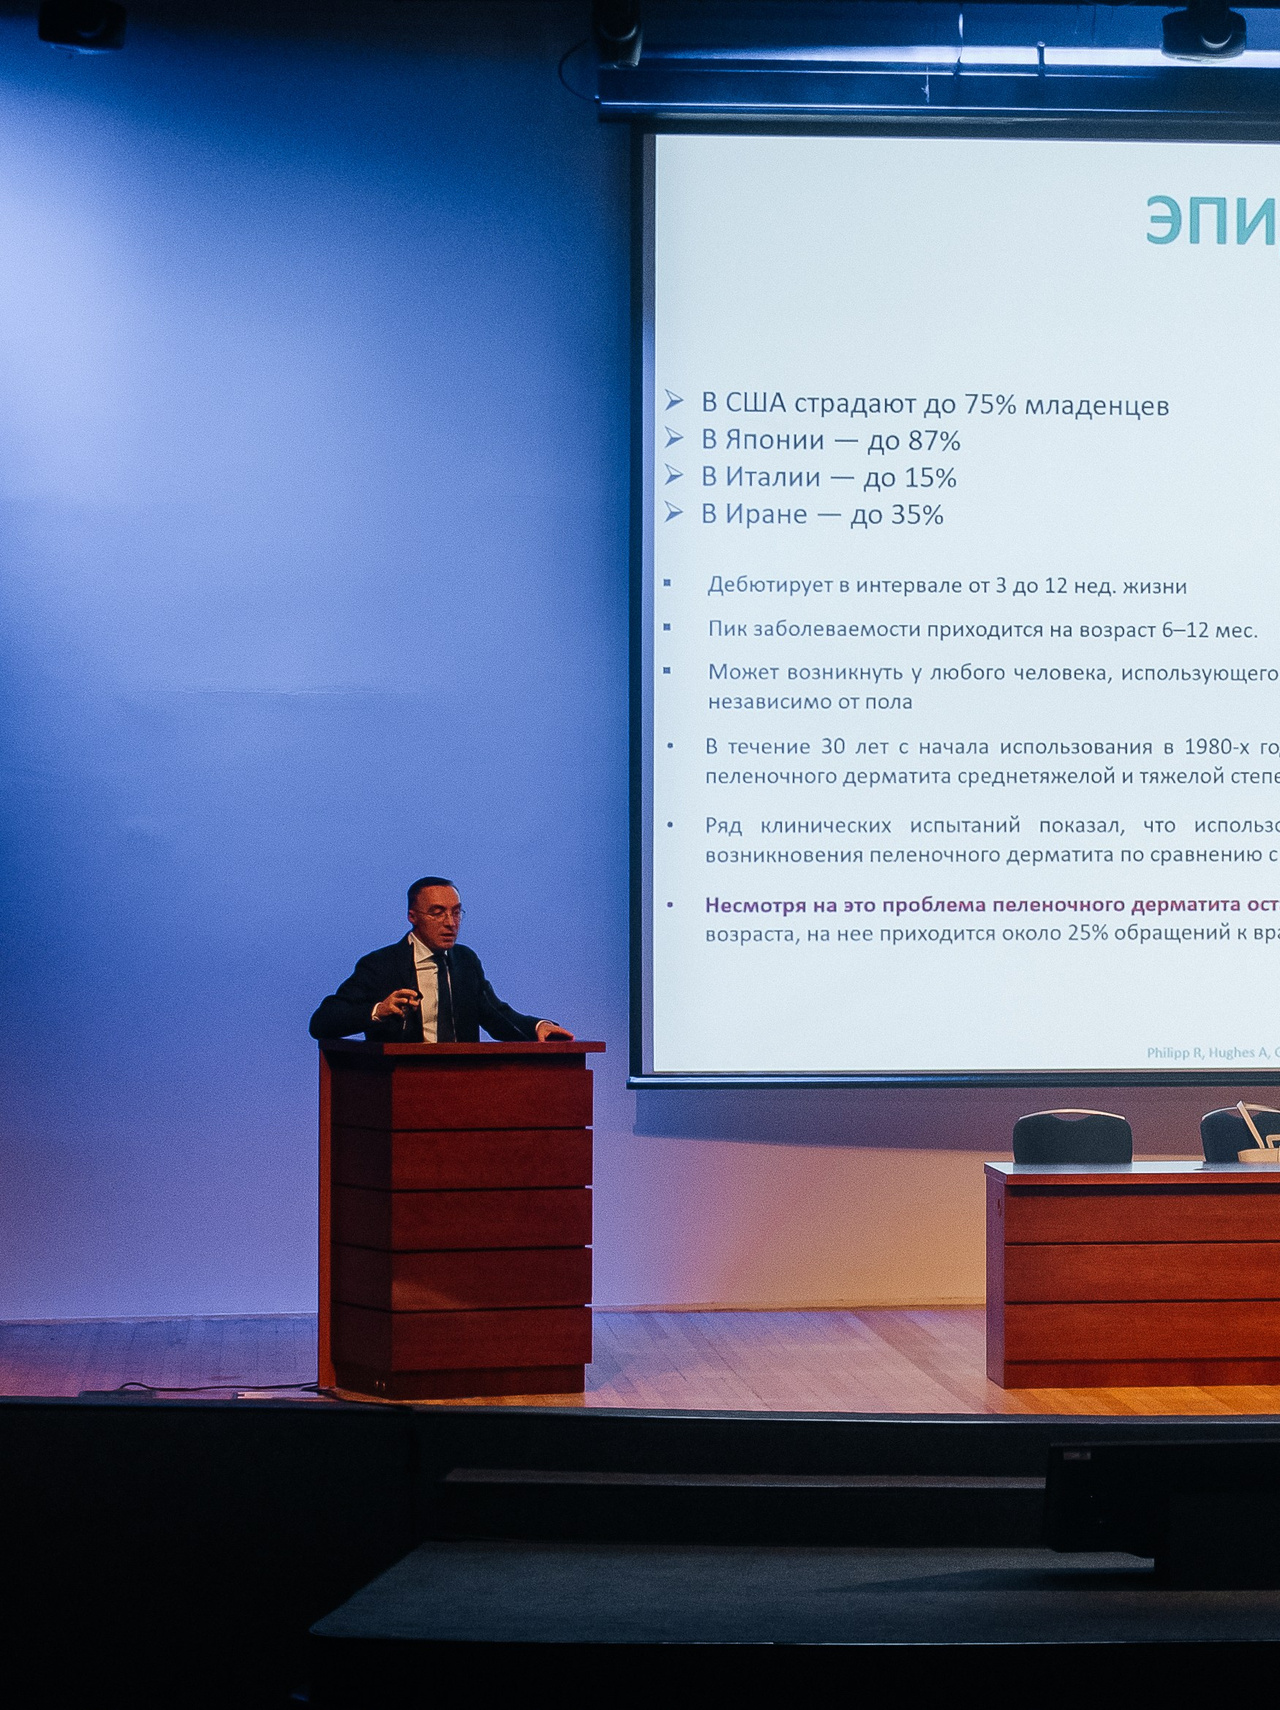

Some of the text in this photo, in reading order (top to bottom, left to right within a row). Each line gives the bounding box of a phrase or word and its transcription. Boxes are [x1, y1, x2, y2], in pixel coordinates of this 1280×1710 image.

[703, 391, 1169, 420] В США страдают до 75% младенцев
[703, 428, 717, 449] В
[726, 428, 823, 450] Японии
[867, 434, 900, 455] до
[909, 430, 961, 451] 87%
[703, 466, 717, 486] В
[727, 466, 820, 487] Италии
[863, 472, 896, 492] до
[906, 467, 957, 488] 15%
[703, 503, 717, 523] В
[727, 503, 807, 529] Иране
[850, 509, 883, 529] до
[892, 504, 944, 525] 35%
[707, 575, 1186, 597] Дебютирует в интервале от 3 до 12 нед. жизни
[709, 619, 1257, 642] Пик заболеваемости приходится на возраст 6–12 мес.
[709, 663, 779, 680] Может
[788, 667, 903, 684] возникнуть
[912, 668, 922, 684] у
[930, 663, 1005, 680] любого
[1014, 668, 1112, 684] человека,
[1122, 668, 1279, 685] использующего
[709, 697, 912, 709] независимо от пола
[706, 817, 742, 836] Ряд
[761, 821, 891, 833] клинических
[911, 815, 1020, 833] испытаний
[1040, 820, 1125, 836] показал,
[1144, 820, 1176, 833] что
[706, 850, 863, 863] возникновения
[870, 850, 1000, 862] пеленочного
[1006, 850, 1113, 866] дерматита
[1121, 850, 1144, 862] по
[1150, 850, 1262, 866] сравнению
[1269, 850, 1278, 862] с
[1147, 1047, 1190, 1060] Philipp
[1193, 1047, 1205, 1060] R,
[1209, 1047, 1255, 1060] Hughes
[1258, 1047, 1271, 1060] A,
